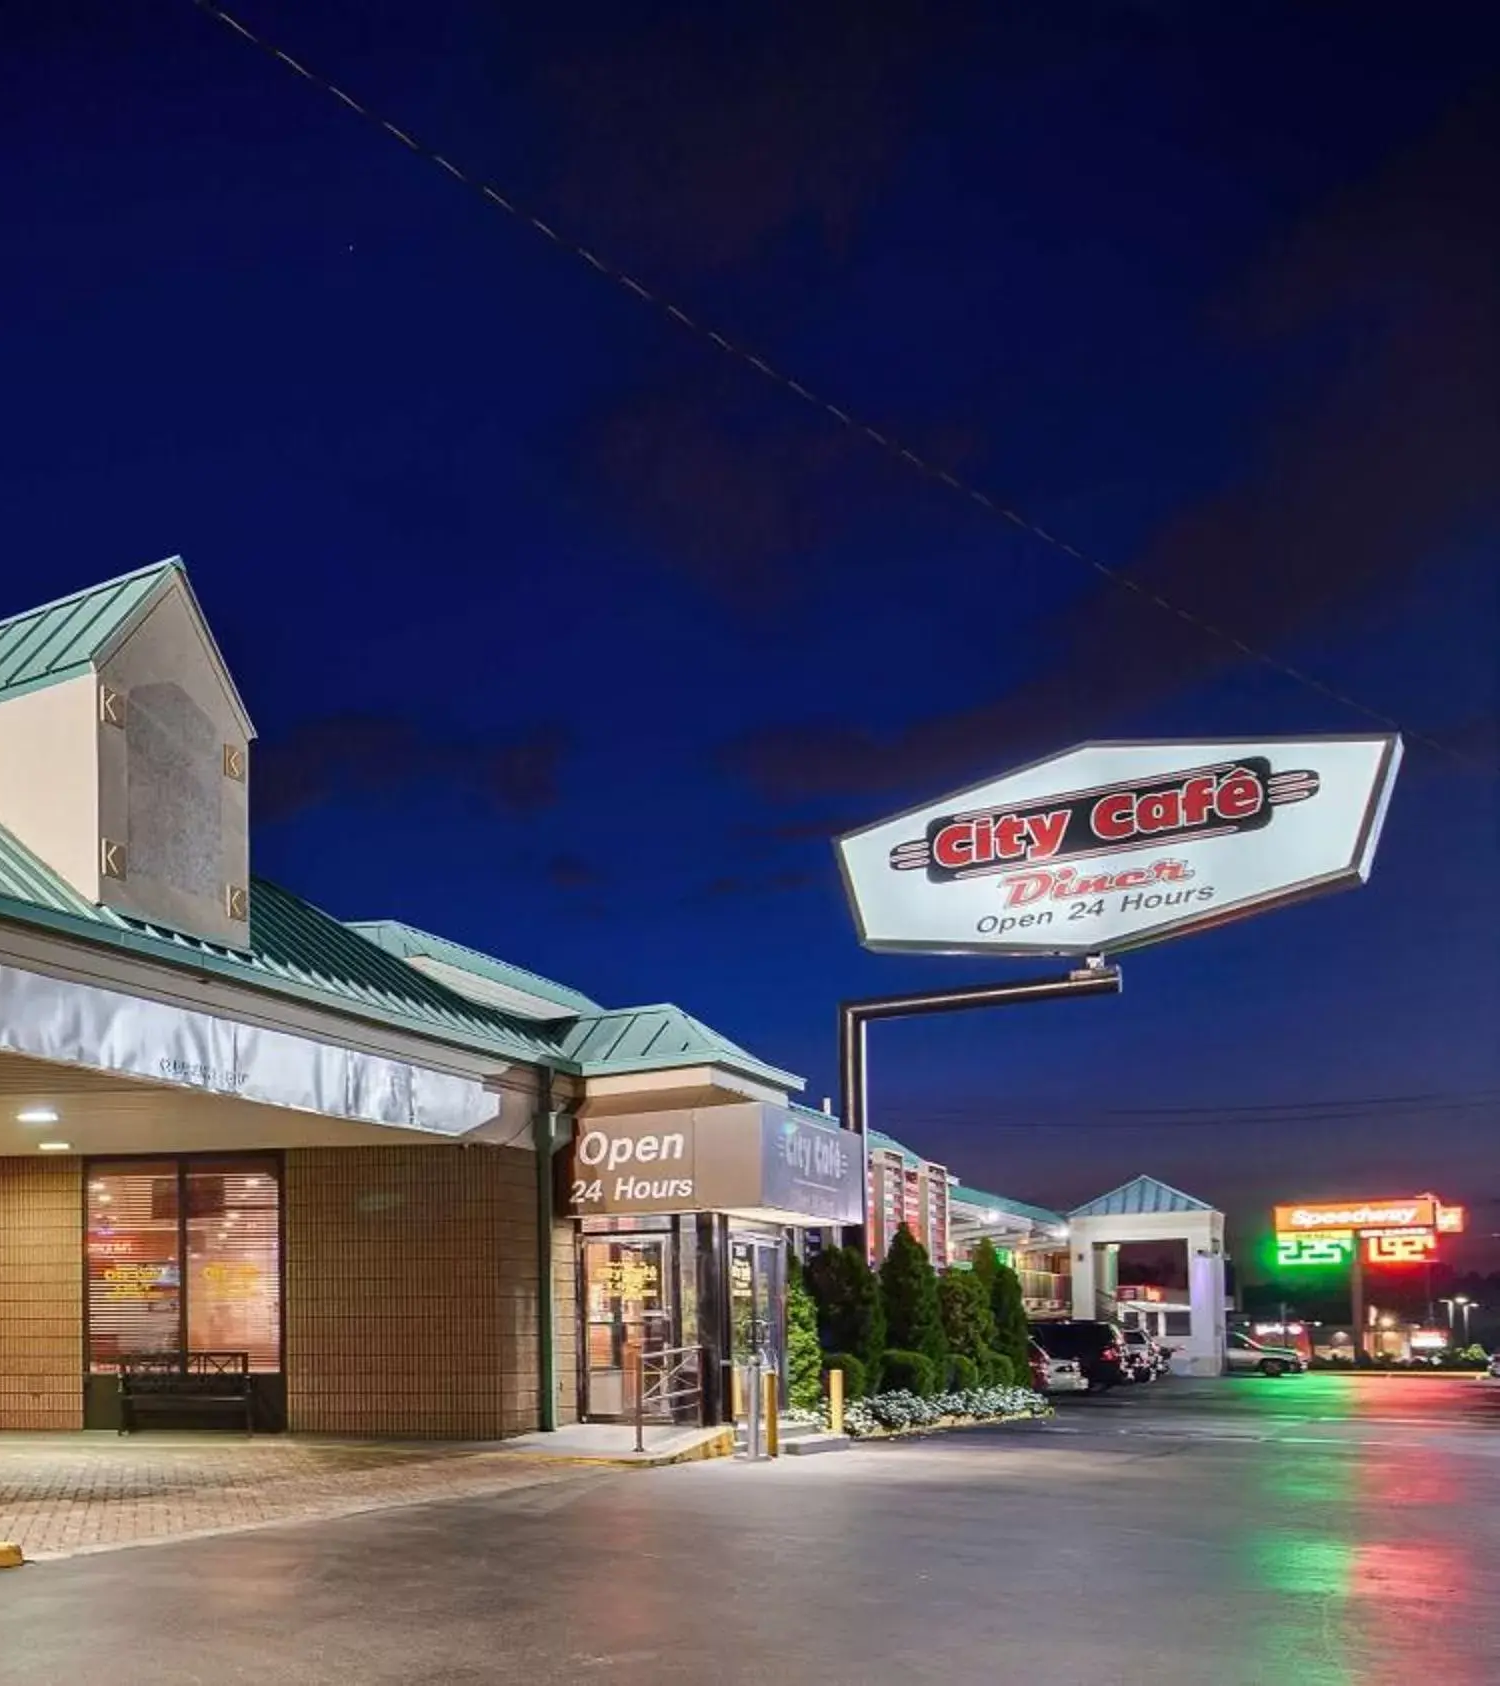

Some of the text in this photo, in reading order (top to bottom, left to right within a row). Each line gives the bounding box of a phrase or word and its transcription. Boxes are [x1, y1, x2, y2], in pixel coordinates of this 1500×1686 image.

[934, 810, 1072, 868] City
[1000, 858, 1195, 909] Diner
[975, 884, 1215, 935] Open 24 Hours
[578, 1131, 685, 1170] Open
[569, 1176, 693, 1204] 24 Hours
[1291, 1205, 1419, 1229] Speedway
